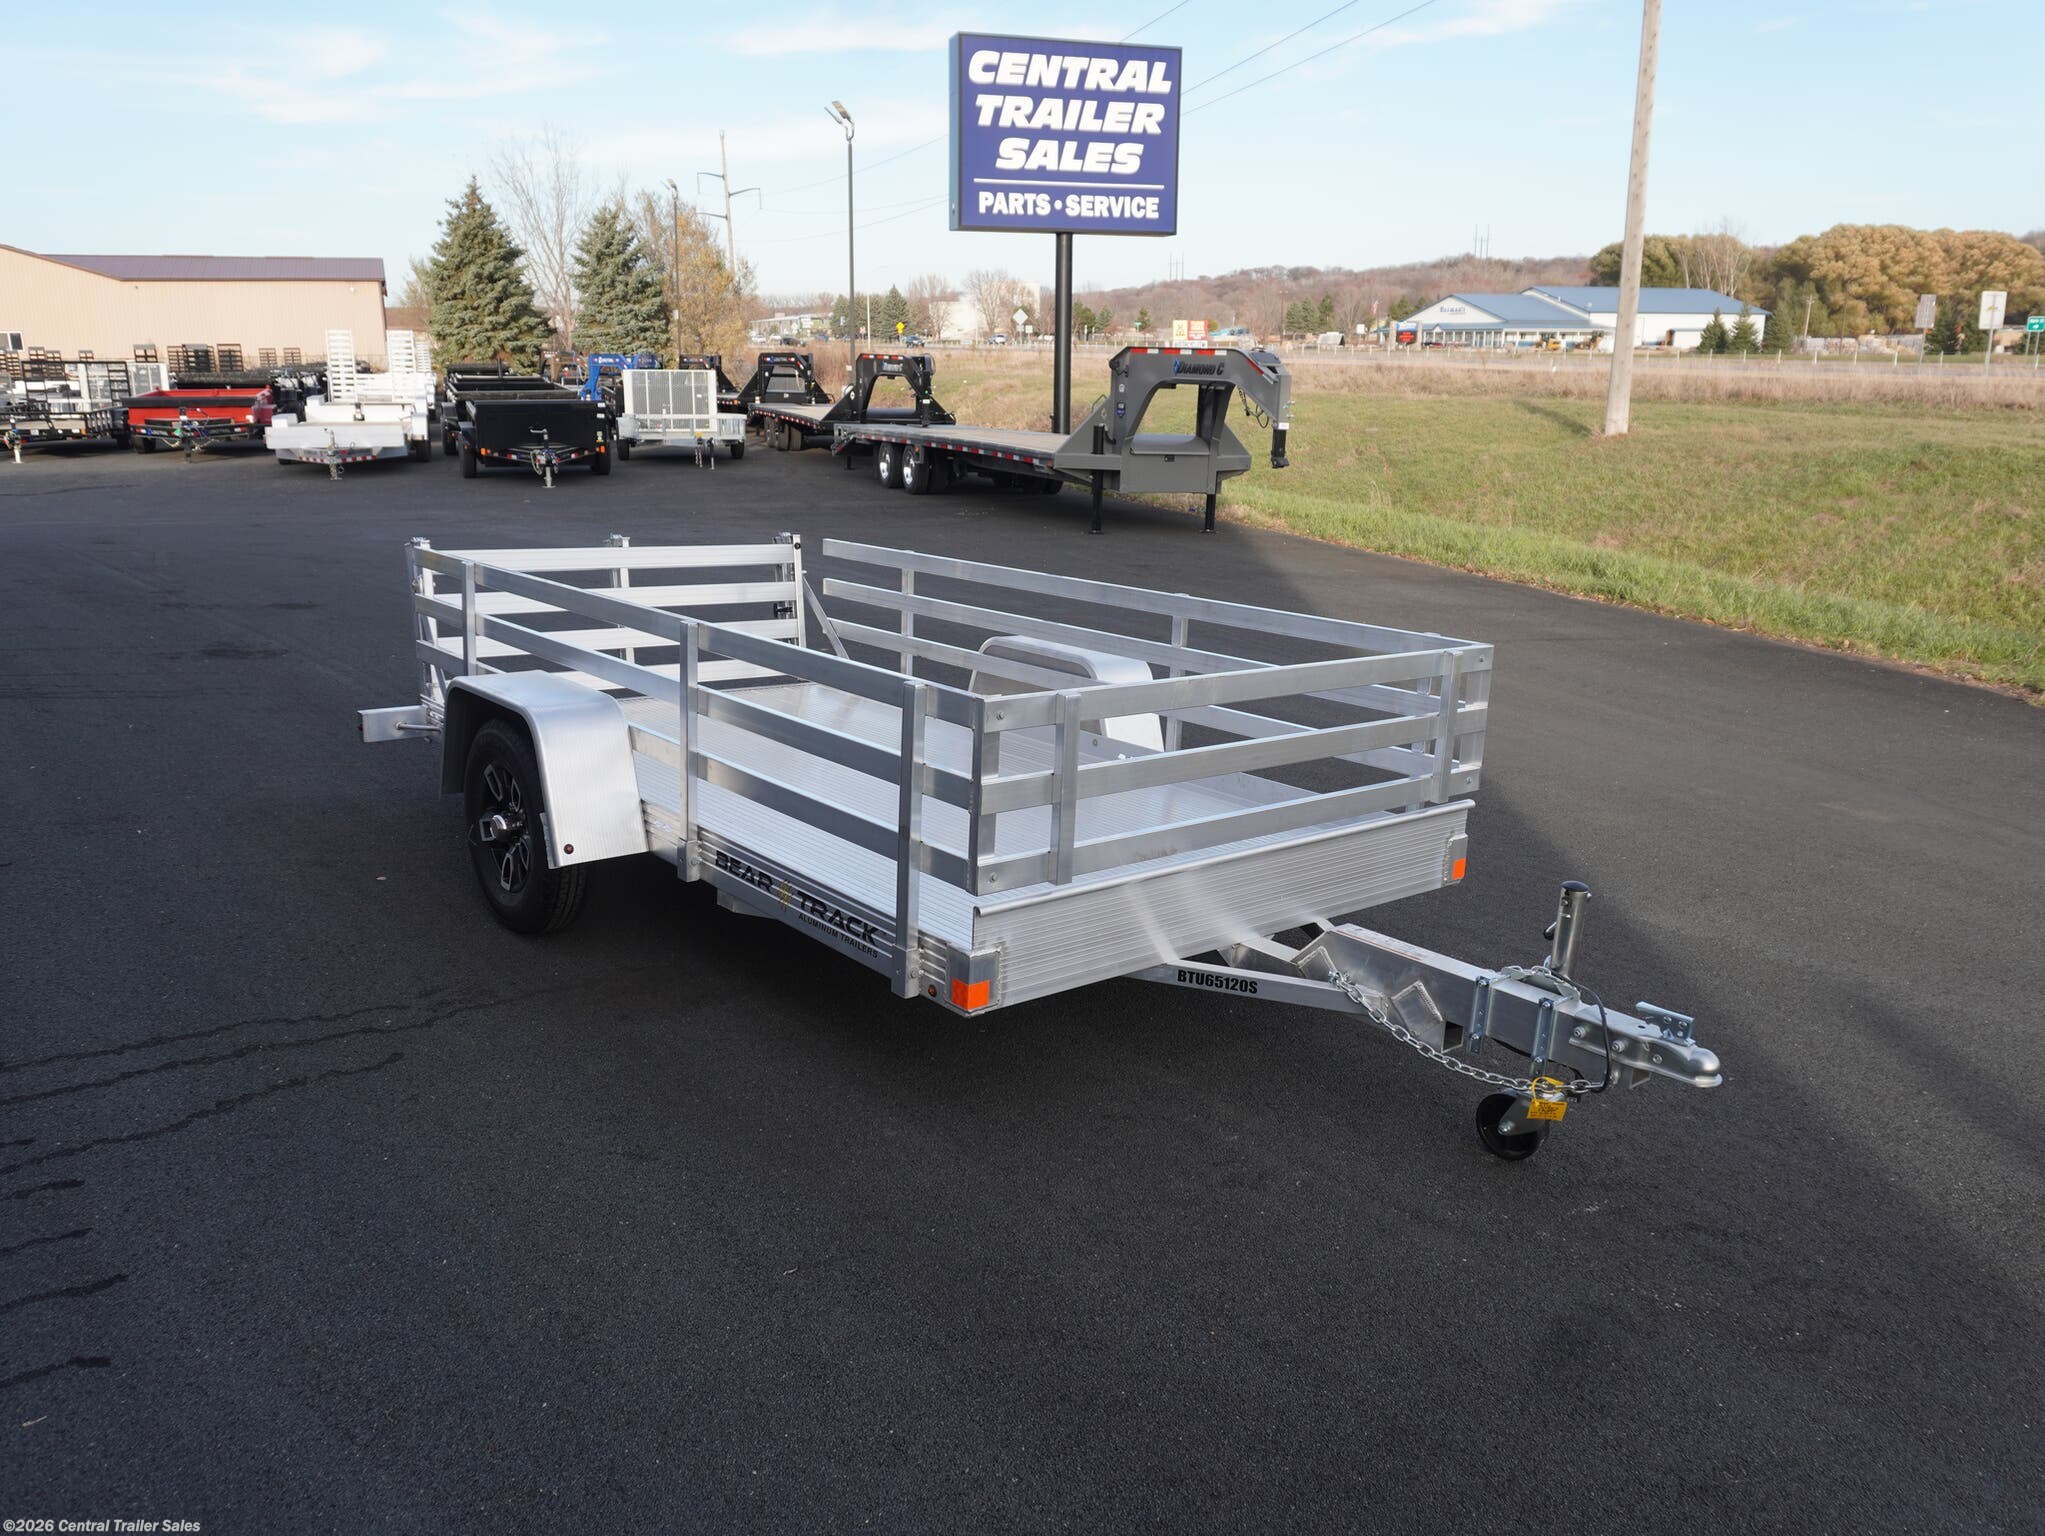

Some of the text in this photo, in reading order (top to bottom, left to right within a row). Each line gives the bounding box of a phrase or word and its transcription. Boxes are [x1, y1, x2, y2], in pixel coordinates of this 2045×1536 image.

[968, 50, 1173, 94] CENTRAL
[975, 94, 1166, 135] TRAILER
[995, 137, 1145, 175] SALES
[978, 191, 1160, 219] PARTS SERVICE
[715, 850, 880, 947] BEAR TRACK
[798, 912, 878, 959] ALUMINUM TRAILERS
[1177, 969, 1258, 994] BTU65120S
